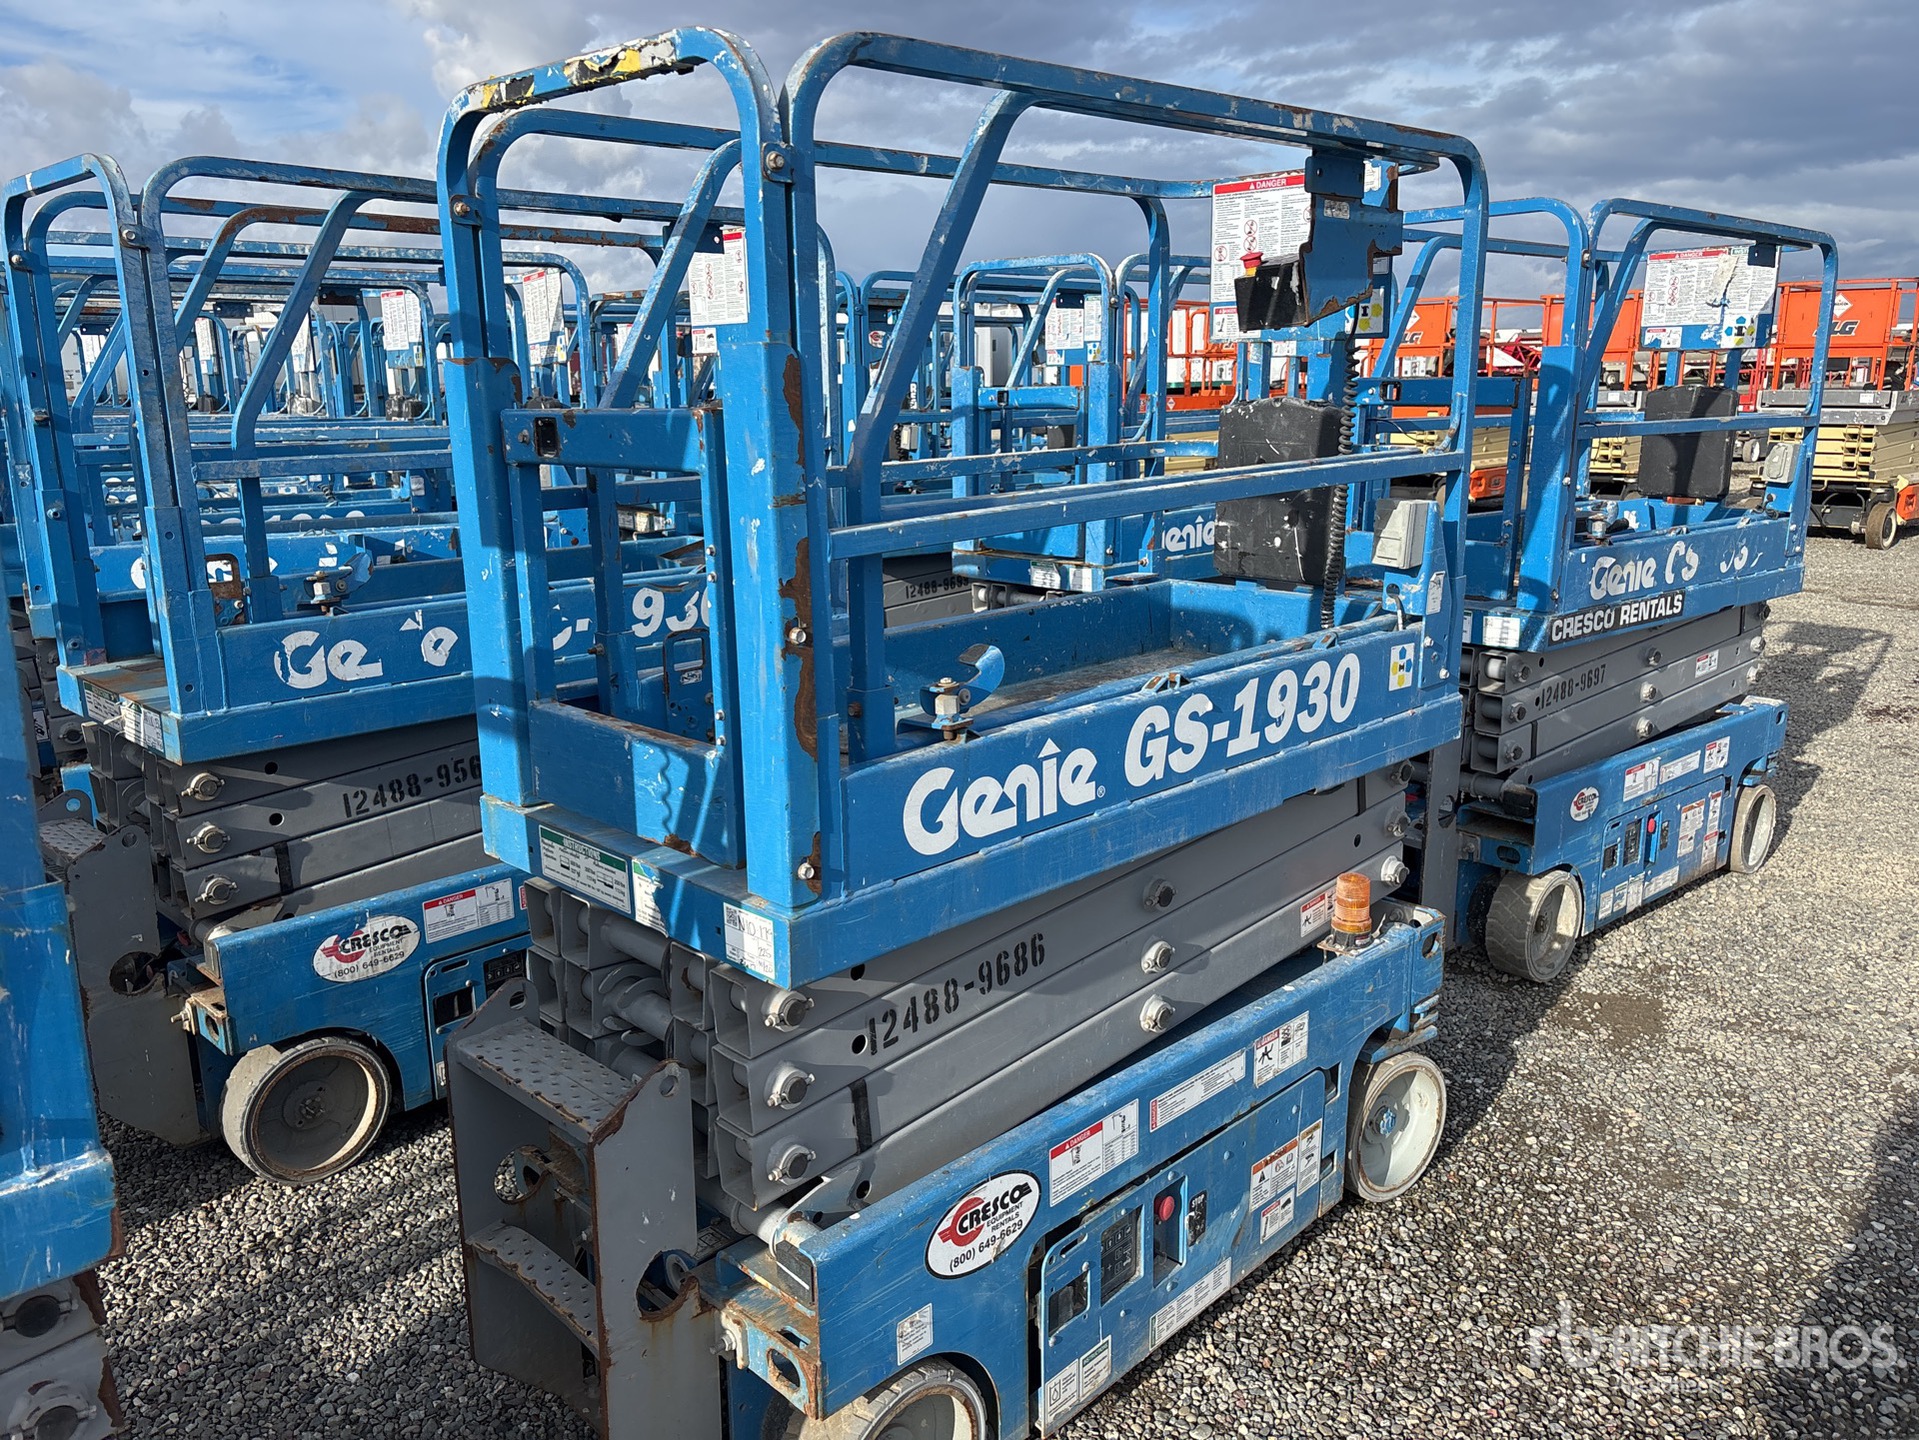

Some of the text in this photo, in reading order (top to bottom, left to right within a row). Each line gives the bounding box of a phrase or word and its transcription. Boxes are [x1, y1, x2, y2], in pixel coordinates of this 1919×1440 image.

[1256, 178, 1287, 190] DANGER
[1813, 320, 1860, 337] LG
[1161, 515, 1215, 552] enie
[1589, 556, 1657, 600] Genie
[1551, 593, 1683, 642] CRESCO RENTALS
[1541, 664, 1607, 710] 12488-9697
[1124, 653, 1360, 787] GS-1930
[903, 737, 1098, 856] Genie
[340, 925, 407, 954] CRESCO
[369, 939, 404, 953] EQUIPMENT
[334, 951, 405, 979] (800) 649-6629
[868, 932, 1045, 1056] 12488-9686
[1069, 1130, 1091, 1147] DANGER
[958, 1183, 1028, 1234] CRESCO
[987, 1201, 1024, 1228] EQUIPMENT
[991, 1211, 1020, 1232] RENTALS
[949, 1219, 1023, 1272] (800) 649-6629
